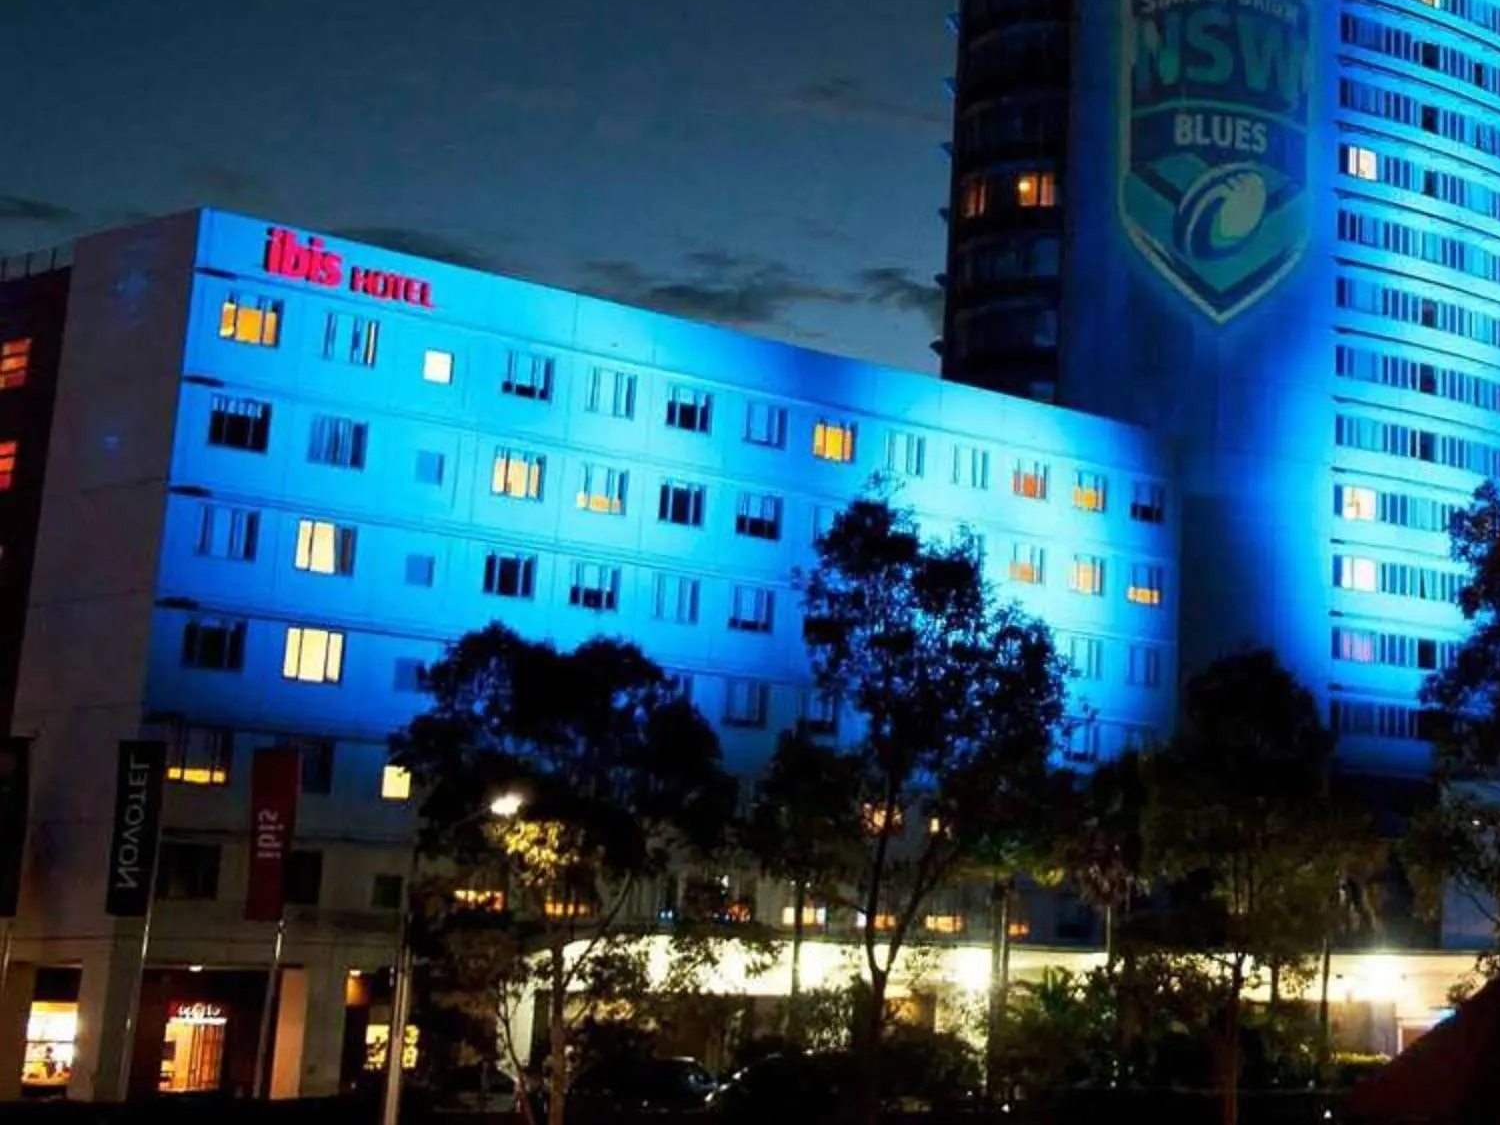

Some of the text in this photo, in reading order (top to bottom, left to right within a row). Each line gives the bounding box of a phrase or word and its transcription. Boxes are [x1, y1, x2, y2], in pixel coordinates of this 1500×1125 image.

[1134, 7, 1314, 103] NSW
[1174, 113, 1268, 154] BLUES
[264, 226, 434, 309] ibis HOTEL
